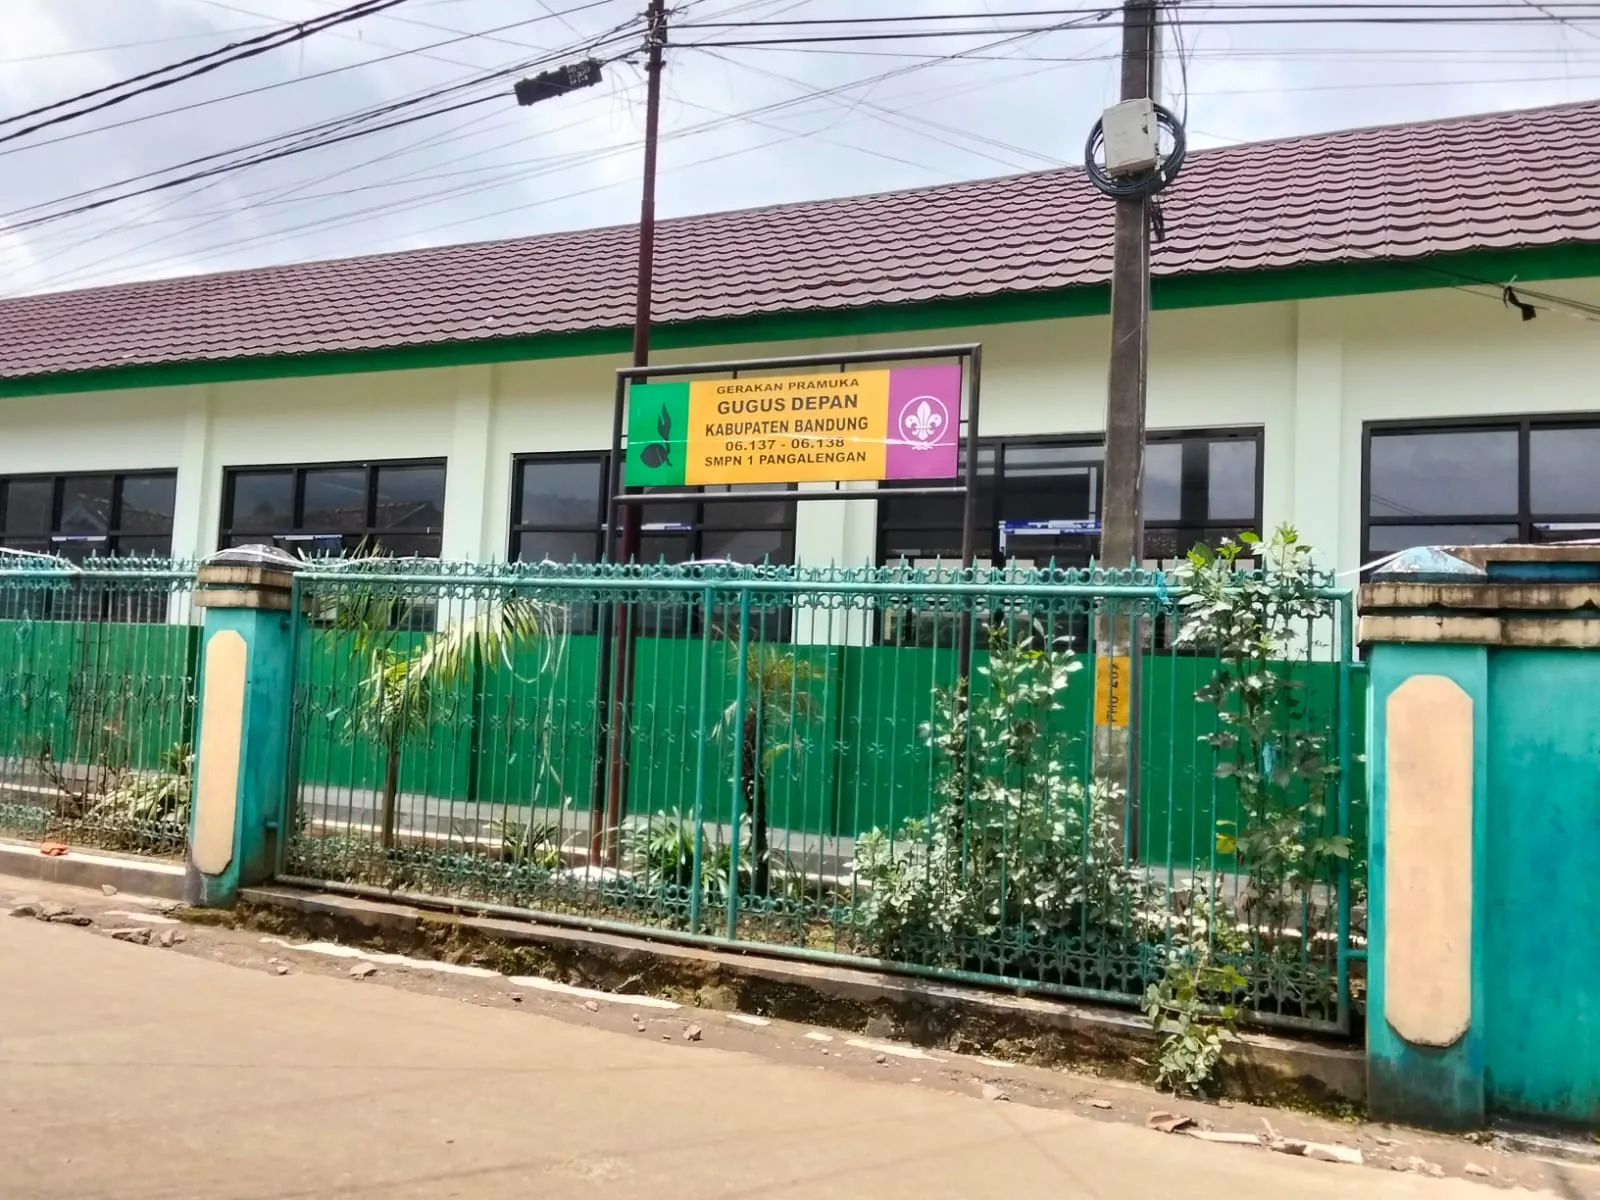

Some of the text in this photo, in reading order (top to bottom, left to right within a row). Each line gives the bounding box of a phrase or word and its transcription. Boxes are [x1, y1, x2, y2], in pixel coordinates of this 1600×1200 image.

[717, 378, 860, 394] GERAKAN PRAMUKA
[717, 394, 858, 415] GUGUS DEPAN
[705, 417, 868, 437] KABUPATEN BANDUNG
[726, 439, 776, 451] 06.137
[791, 437, 845, 450] 06.138
[705, 451, 866, 467] SMPN 1 PANGALENGAN
